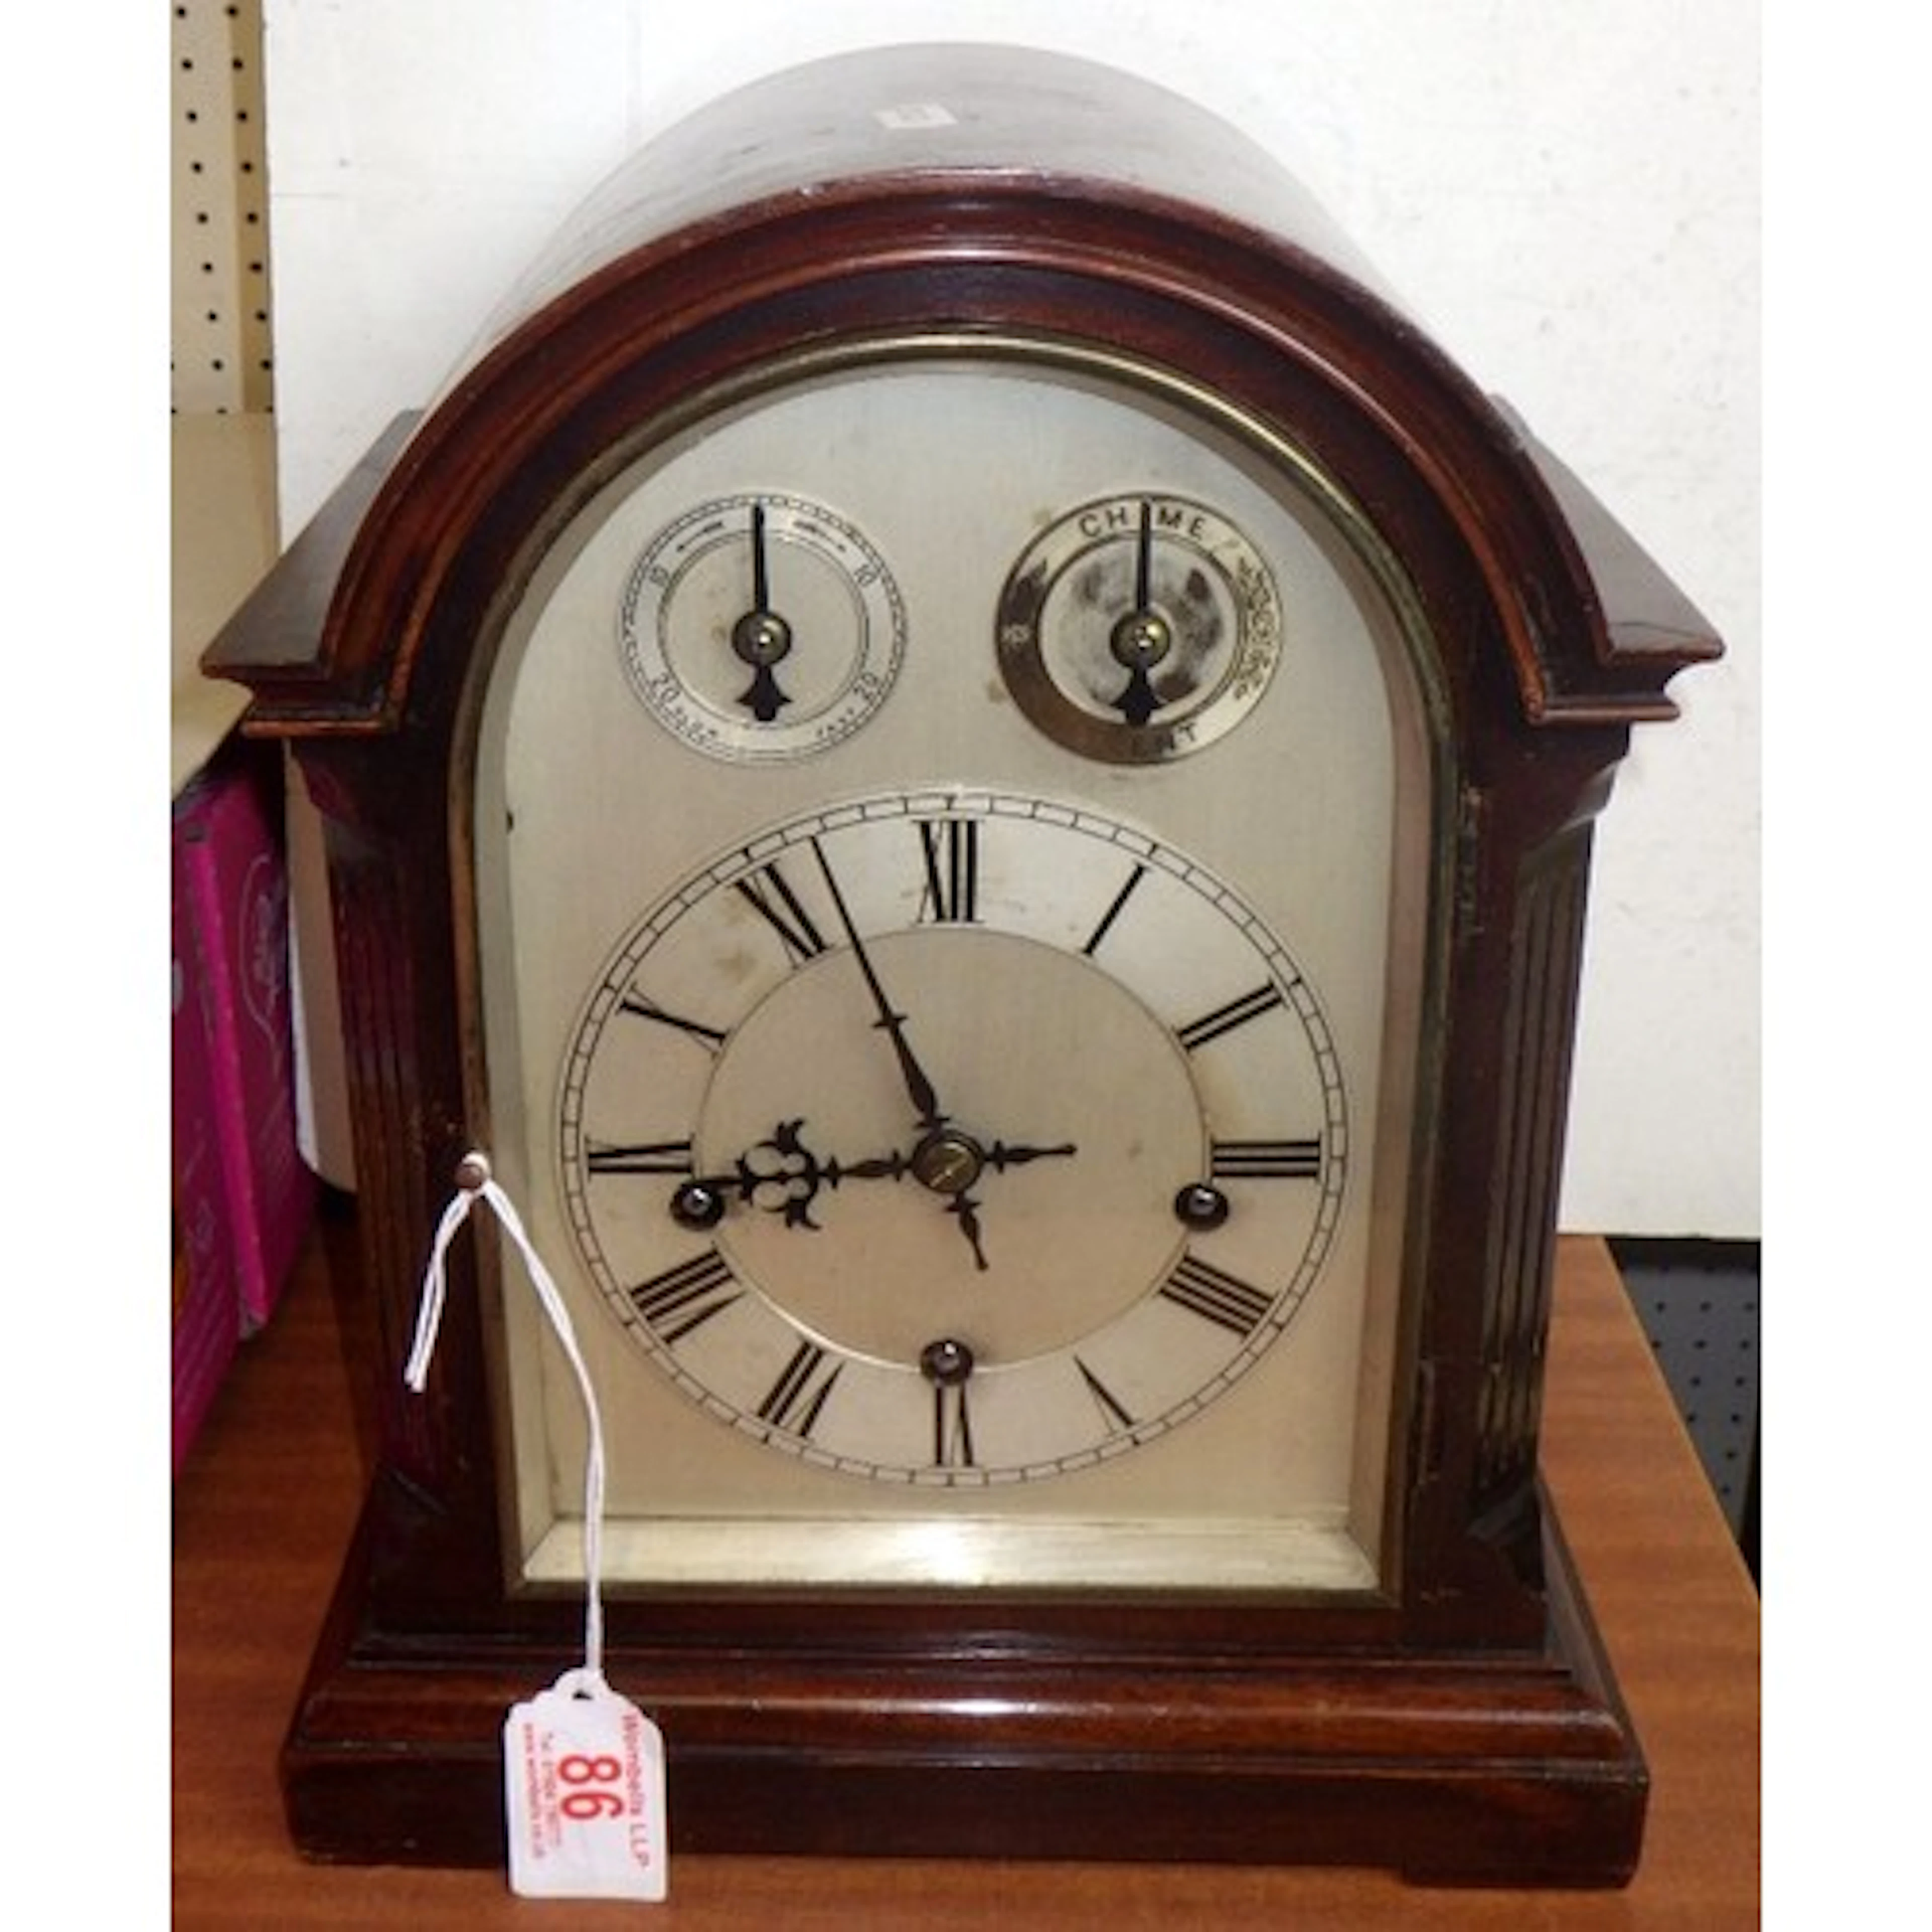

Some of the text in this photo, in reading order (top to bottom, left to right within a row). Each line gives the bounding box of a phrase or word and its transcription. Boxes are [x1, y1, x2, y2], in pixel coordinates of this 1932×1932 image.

[1078, 506, 1207, 539] CHME
[854, 562, 877, 587] 10
[653, 672, 680, 703] 20
[910, 819, 985, 924] XII
[1078, 860, 1152, 957] I
[726, 858, 834, 970] XI
[615, 981, 734, 1061] X
[1171, 975, 1290, 1059] II
[585, 1133, 695, 1182] IX
[1211, 1132, 1321, 1185] III
[623, 1240, 748, 1350] VIII
[1153, 1245, 1278, 1343] IIII
[749, 1335, 846, 1444] VII
[1073, 1354, 1143, 1437] V
[558, 1754, 624, 1820] 86
[629, 1822, 651, 1867] LLP
